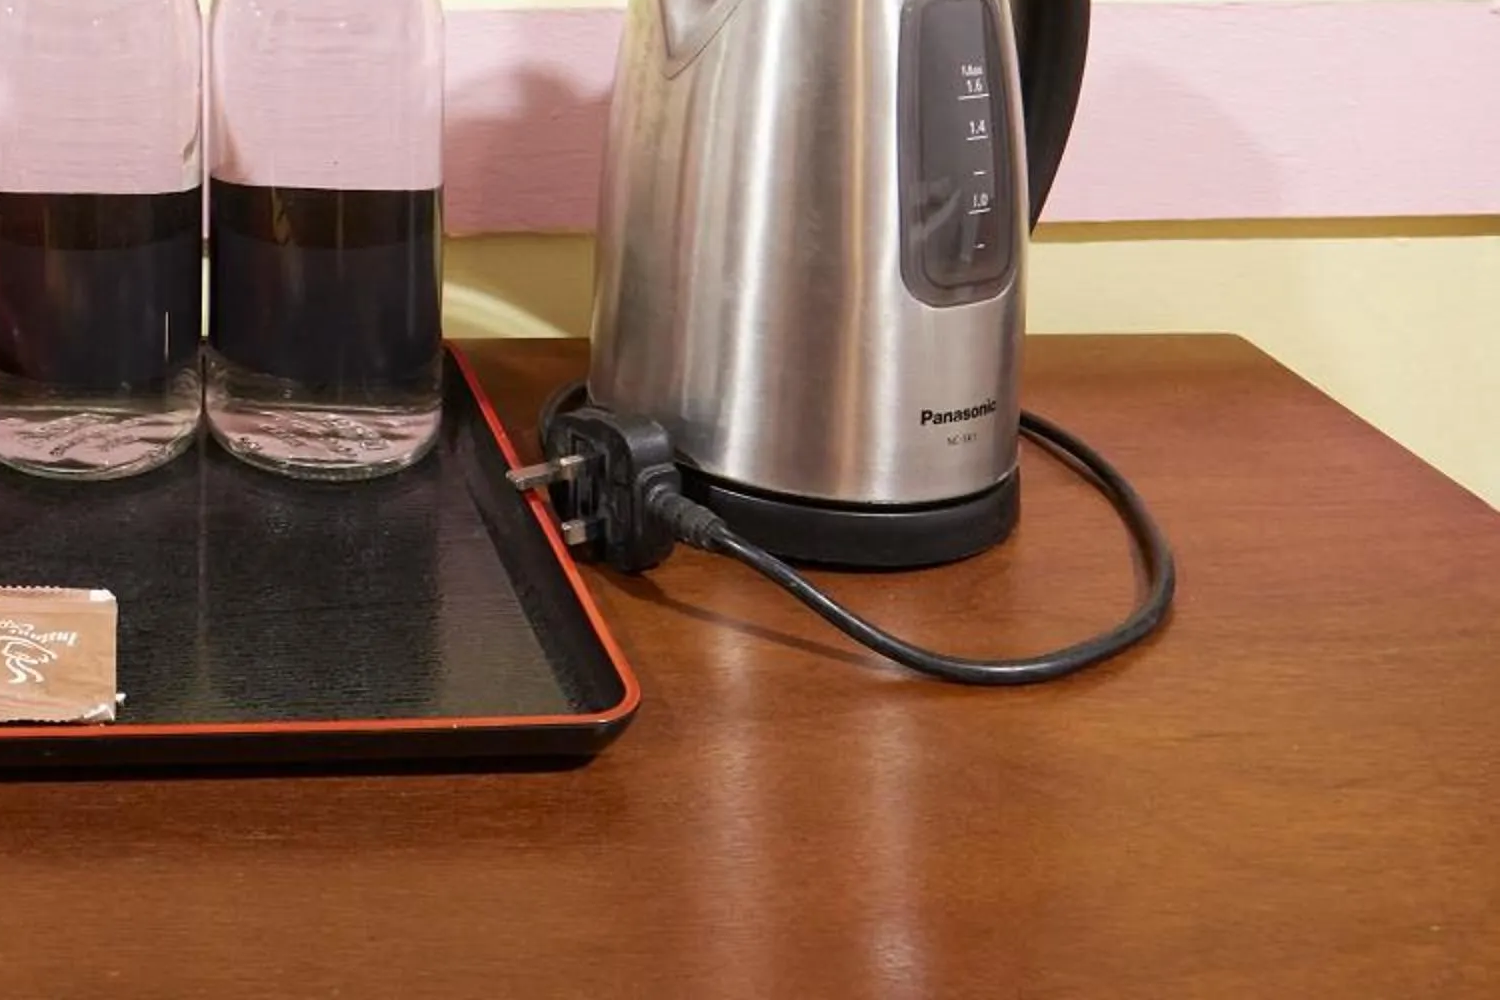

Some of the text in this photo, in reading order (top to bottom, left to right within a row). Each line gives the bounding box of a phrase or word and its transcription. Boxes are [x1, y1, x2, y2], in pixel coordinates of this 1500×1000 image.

[966, 78, 983, 93] 1.6
[969, 120, 986, 134] 1.4
[972, 193, 989, 208] 1.0
[920, 399, 997, 426] Panasonic
